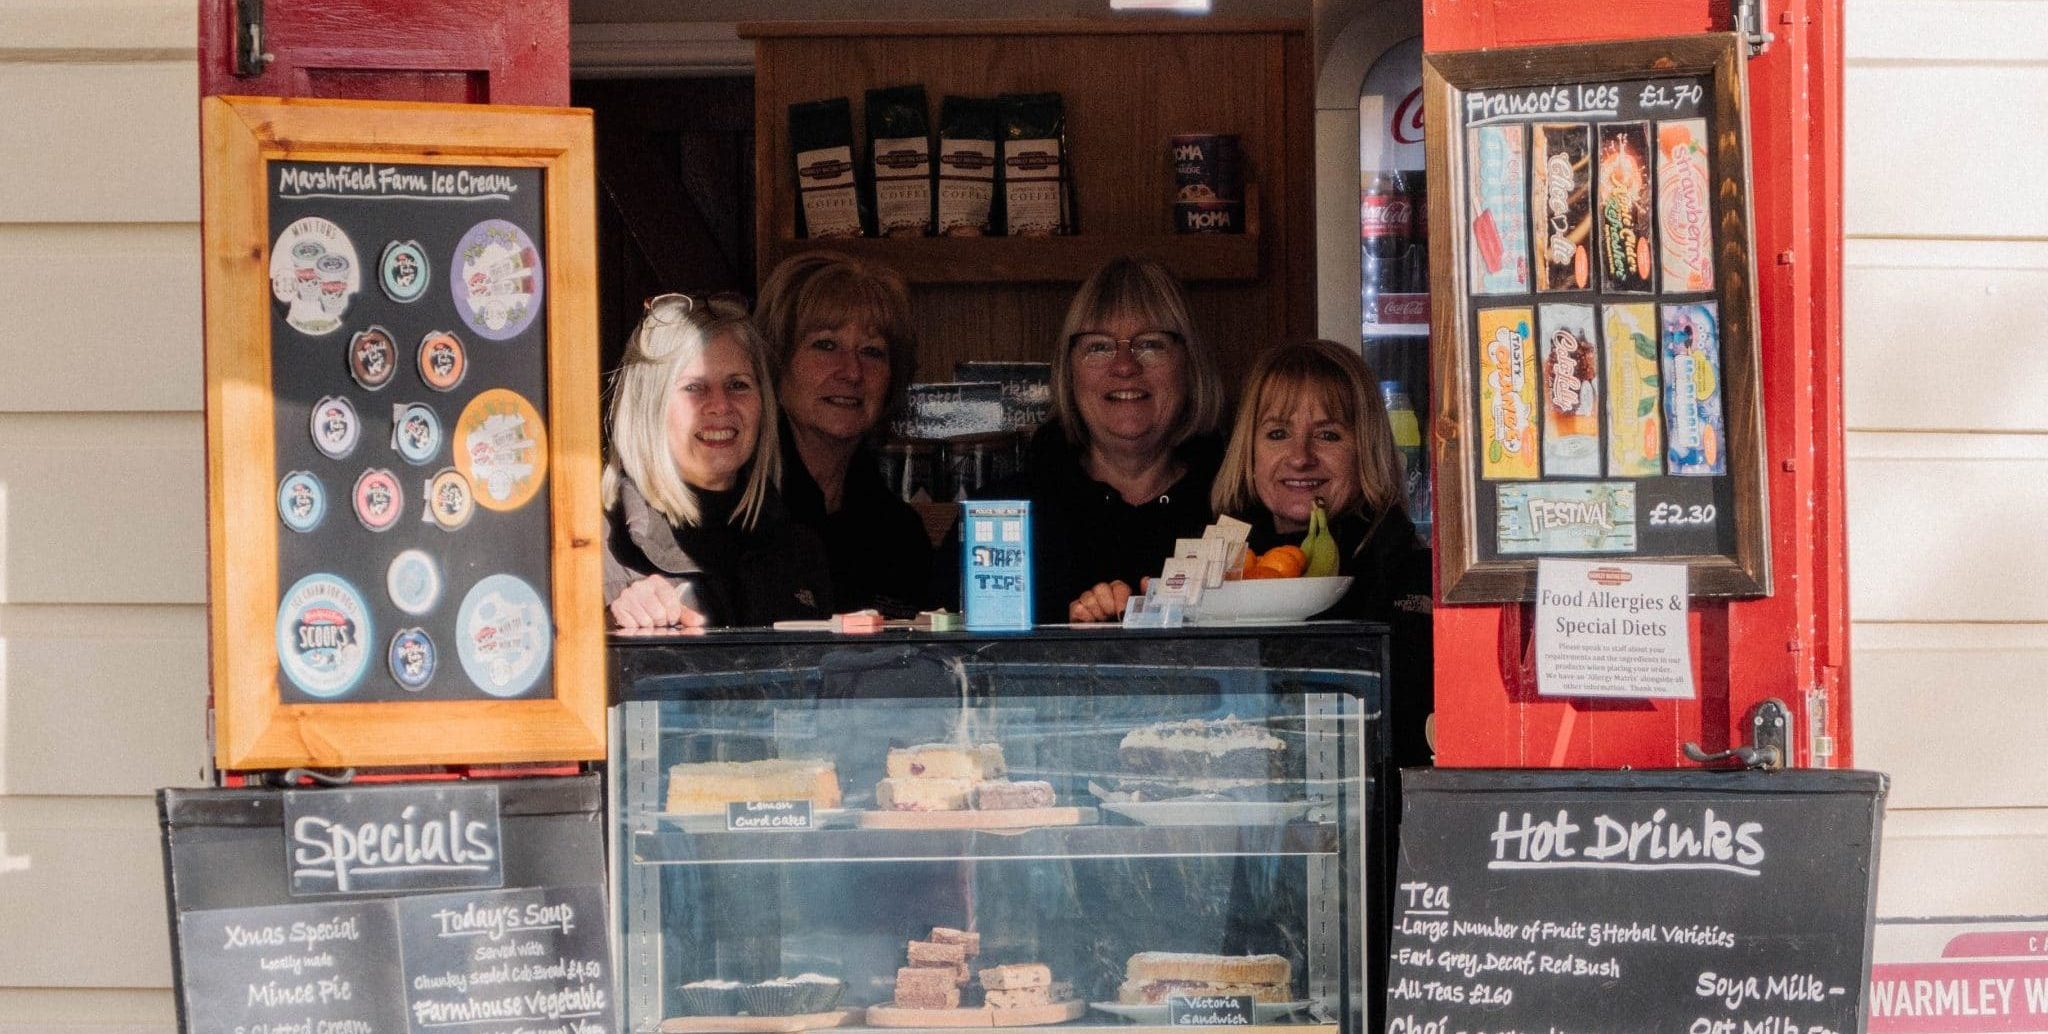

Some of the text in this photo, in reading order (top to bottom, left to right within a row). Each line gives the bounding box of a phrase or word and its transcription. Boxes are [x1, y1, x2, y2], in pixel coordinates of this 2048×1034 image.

[1466, 84, 1619, 123] Franco's Ices
[1639, 84, 1703, 109] £1.70
[279, 163, 518, 194] Marshfield Farm Ice Cream
[1187, 210, 1232, 229] MOMA
[1512, 336, 1522, 378] TASTY
[1528, 500, 1614, 535] FESTIVAL
[1650, 502, 1716, 525] £2.30
[975, 574, 1025, 592] TIPS
[1542, 589, 1682, 613] Food Allergies &
[1556, 617, 1667, 637] Special Diets
[294, 806, 494, 891] Specials
[1490, 808, 1766, 865] Hot Drinks
[1400, 881, 1450, 909] Tea
[223, 916, 359, 951] Xmas Special
[431, 902, 574, 940] Today's Soup
[1453, 916, 1518, 939] Number
[1521, 919, 1541, 943] of
[1542, 921, 1585, 940] Fruit
[1587, 923, 1602, 946] &
[1602, 921, 1657, 944] Herbal
[1661, 924, 1735, 948] Varieties
[248, 974, 352, 1007] Mince Pie
[414, 971, 468, 992] Chunky
[1423, 981, 1465, 1002] Teas
[1468, 983, 1513, 1005] £1.60
[1696, 971, 1761, 1010] Soya
[1764, 973, 1825, 1002] Milk
[413, 983, 607, 1024] Farmhouse Vegetable
[1184, 996, 1240, 1009] Victoria
[1870, 978, 2015, 1017] WARMLEY
[1180, 1012, 1249, 1025] Sandwich
